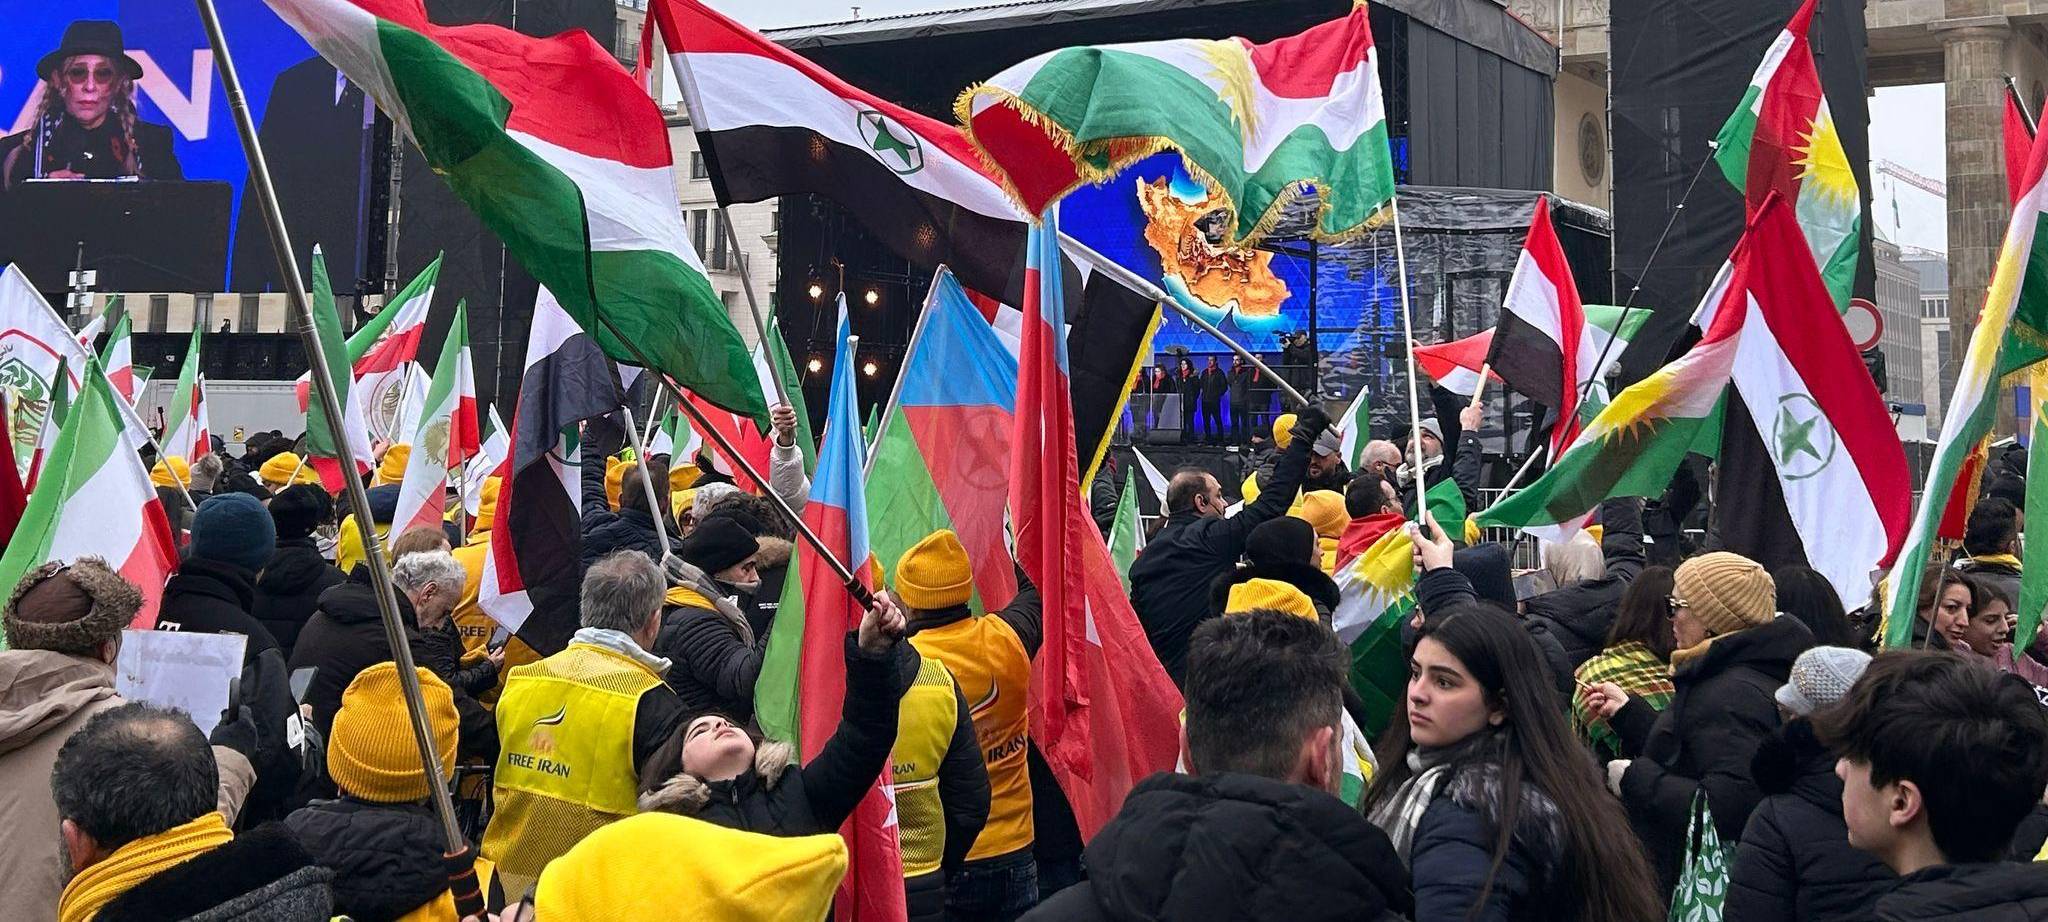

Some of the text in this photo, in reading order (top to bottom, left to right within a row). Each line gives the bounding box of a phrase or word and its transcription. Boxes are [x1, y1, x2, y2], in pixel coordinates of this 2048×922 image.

[458, 625, 486, 637] REE
[507, 752, 571, 779] FREE IRAN
[892, 762, 916, 775] RAN
